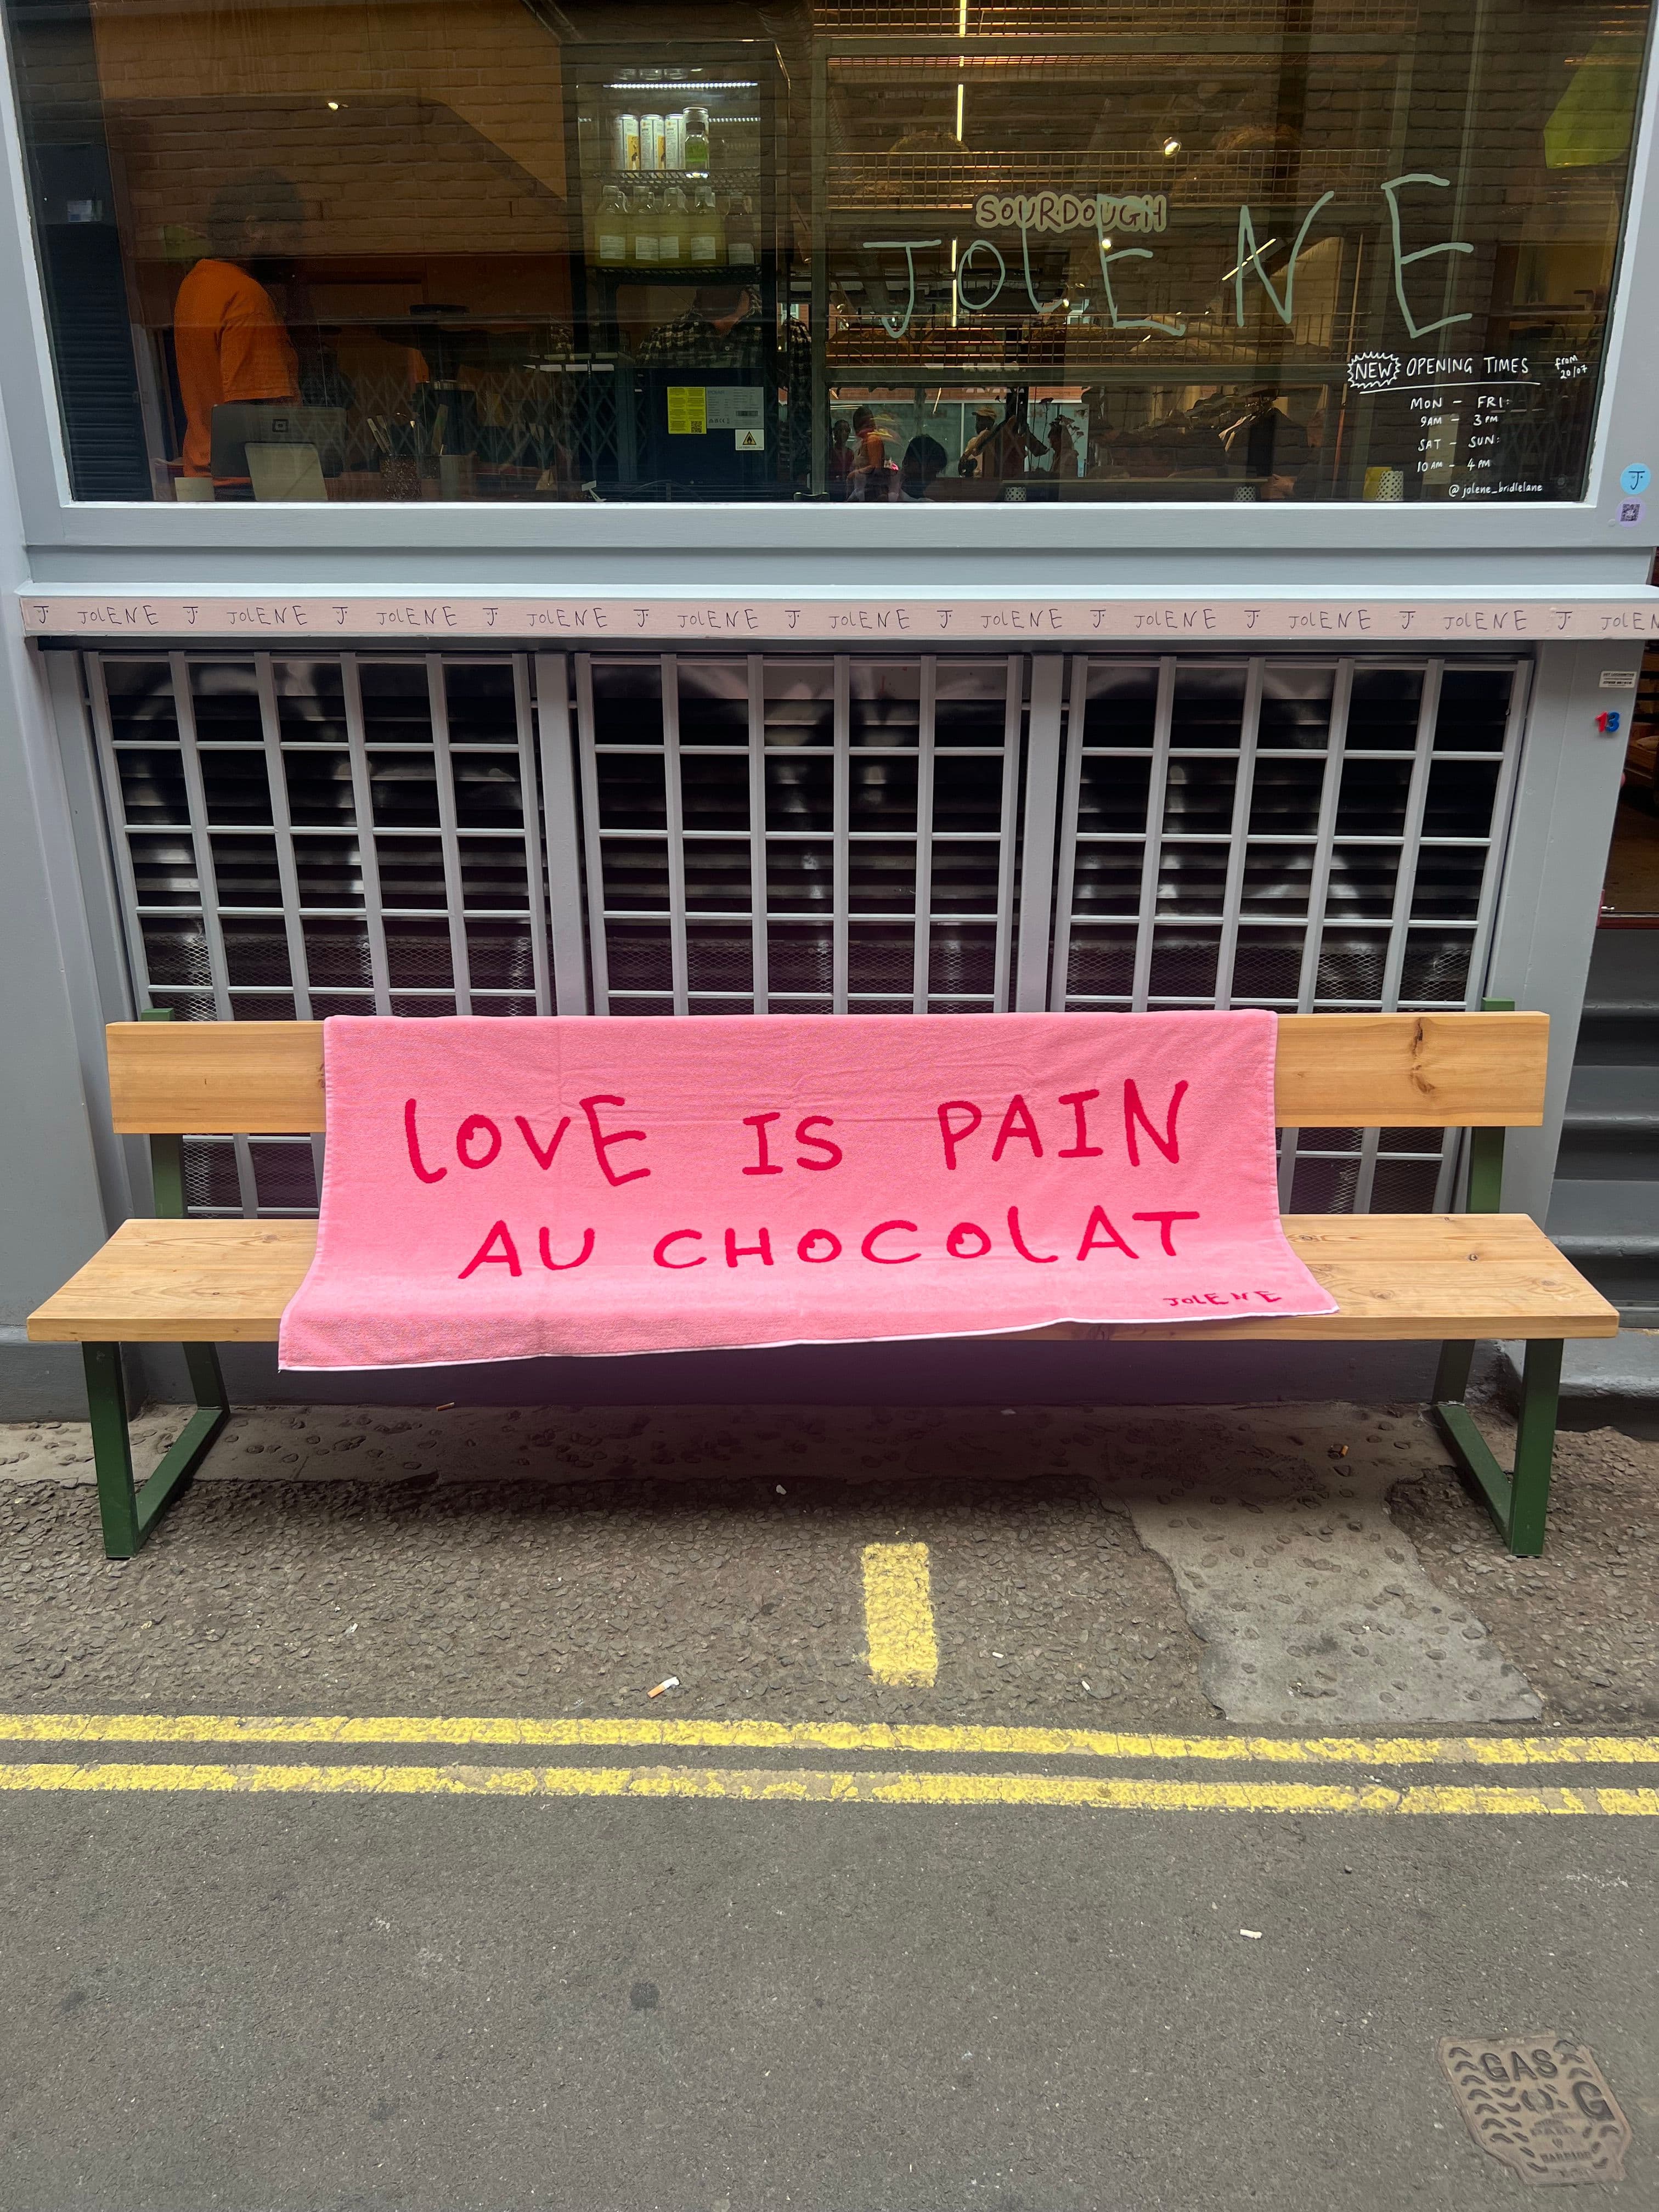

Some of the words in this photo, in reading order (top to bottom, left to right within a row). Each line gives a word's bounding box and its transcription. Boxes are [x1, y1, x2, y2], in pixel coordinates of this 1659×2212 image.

[979, 198, 1164, 228] SOURDOUGH
[862, 173, 1475, 339] JOLENE
[1355, 362, 1393, 380] NEW
[1406, 358, 1473, 376] OPENING
[1483, 356, 1528, 374] TIMES
[1554, 354, 1578, 370] from
[1560, 364, 1588, 379] 20/07
[1410, 397, 1442, 410] MON
[1420, 416, 1442, 427] 9AM
[1418, 439, 1441, 452] SAT
[33, 605, 50, 624] J
[77, 605, 159, 625] JOLENE
[183, 606, 198, 624] J
[227, 606, 307, 625] JOLENE
[332, 606, 348, 624] J
[376, 606, 458, 626] JOLENE
[483, 607, 499, 626] J
[527, 608, 608, 628] JOLENE
[634, 609, 650, 628] J
[677, 609, 759, 629] JOLENE
[785, 610, 801, 629] J
[828, 610, 910, 629] JOLENE
[937, 610, 953, 629] J
[981, 609, 1063, 629] JOLENE
[1090, 610, 1106, 628] J
[1134, 609, 1216, 629] JOLENE
[1244, 610, 1261, 628] J
[1289, 610, 1371, 629] JOLENE
[1400, 611, 1416, 630] J
[1443, 610, 1527, 630] JOLENE
[1556, 611, 1573, 630] J
[1595, 711, 1620, 733] 13
[405, 1094, 651, 1186] LOVE
[742, 1112, 843, 1175] IS
[937, 1078, 1189, 1170] PAIN
[458, 1220, 595, 1279] AU
[653, 1205, 1200, 1269] CHOCOLAT
[1163, 1291, 1282, 1306] JOLENE
[1481, 2049, 1558, 2082] GAS
[1572, 2080, 1616, 2120] G
